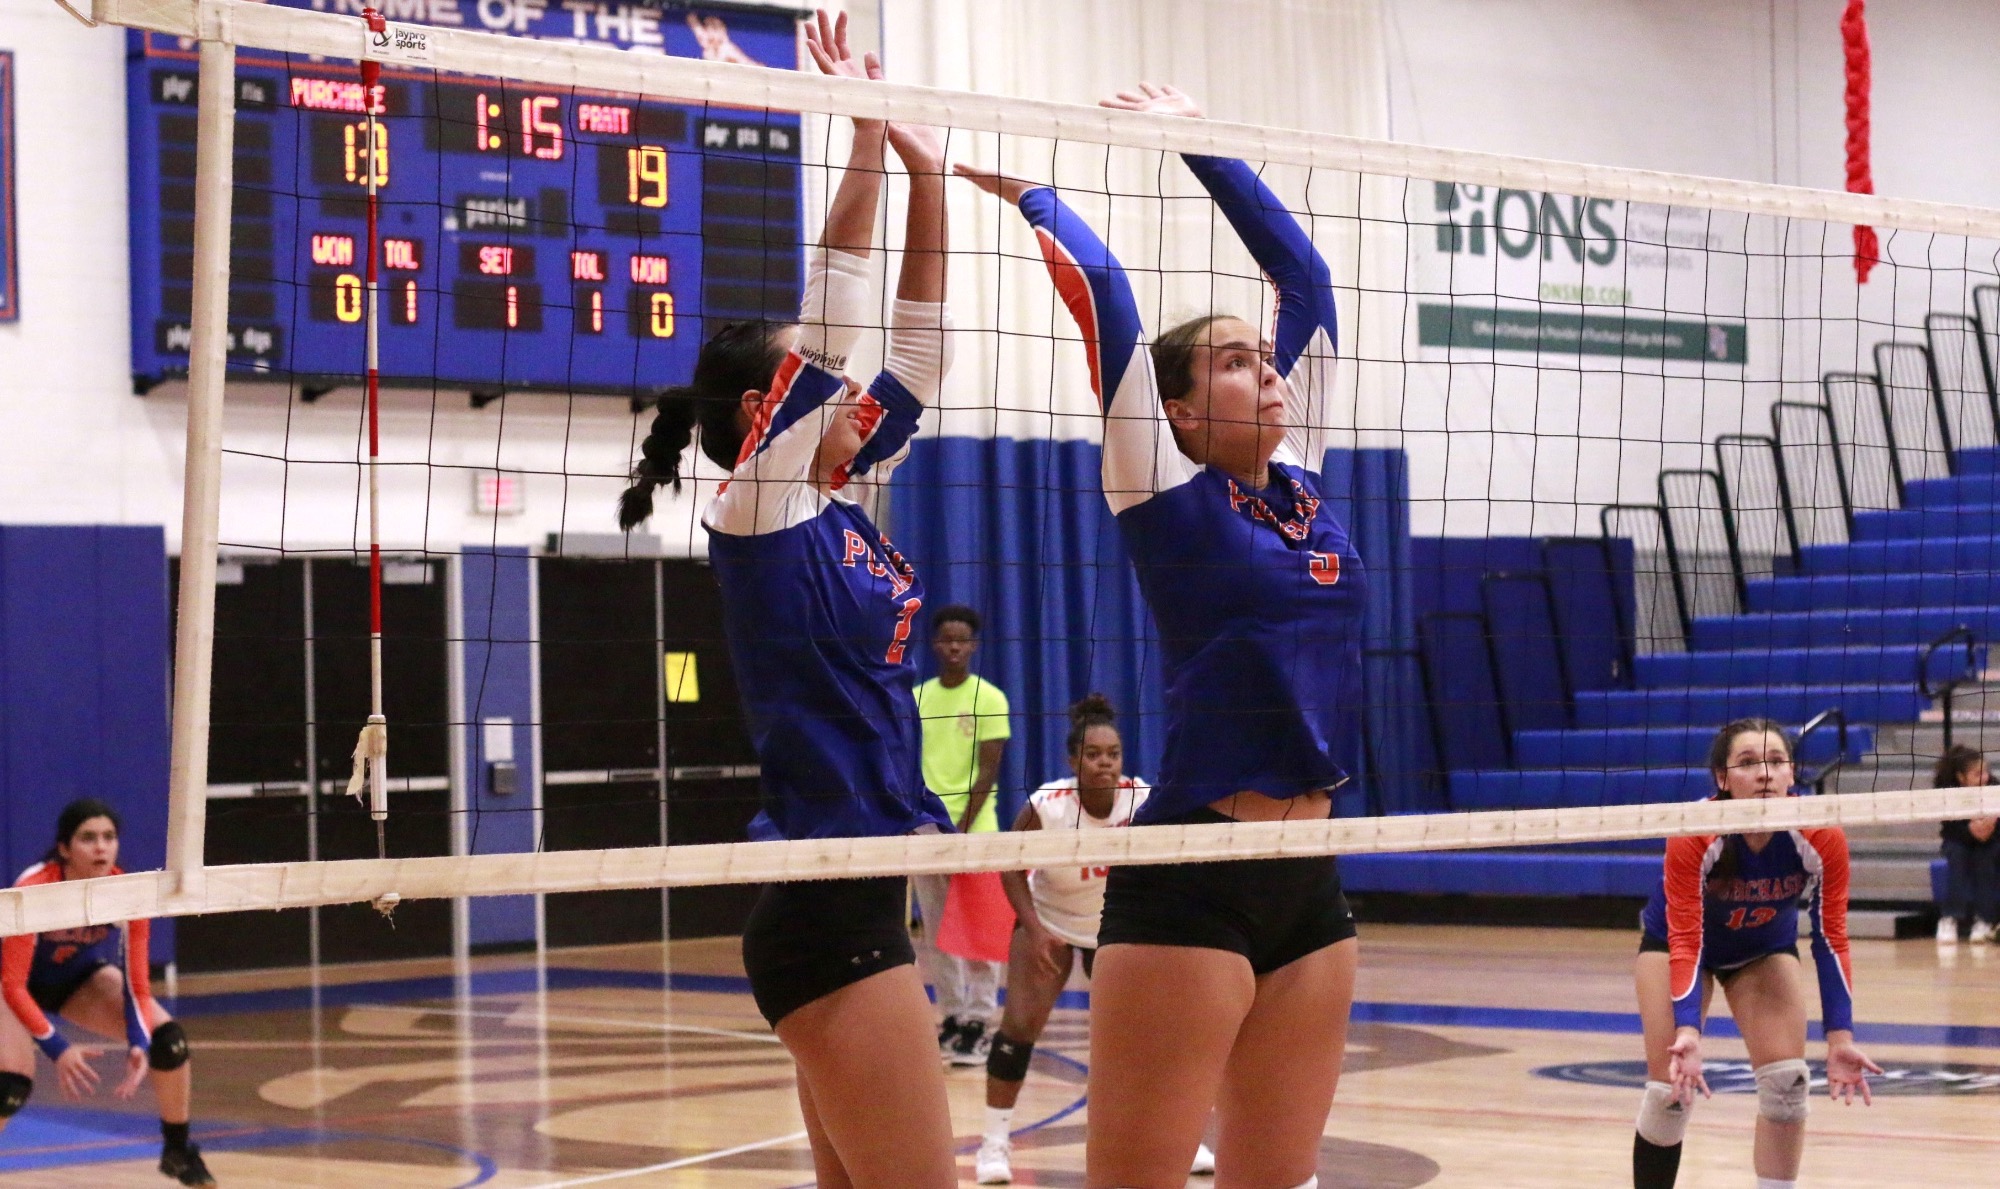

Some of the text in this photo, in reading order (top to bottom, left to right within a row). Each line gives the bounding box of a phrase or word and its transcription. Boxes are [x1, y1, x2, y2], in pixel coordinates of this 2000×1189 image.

[478, 0, 544, 35] OF
[561, 3, 665, 44] THE
[395, 39, 426, 50] sports
[291, 78, 386, 114] PURCHAE
[476, 93, 562, 160] 1:15
[578, 104, 630, 134] PRATT
[628, 145, 668, 208] 19
[1494, 187, 1618, 267] ONS
[384, 239, 418, 269] TOL
[479, 246, 513, 275] SET
[571, 252, 604, 279] TOL
[336, 273, 362, 323] 0
[406, 280, 417, 323] 1
[507, 285, 518, 328] 1
[592, 291, 602, 332] 1
[651, 292, 674, 338] 0
